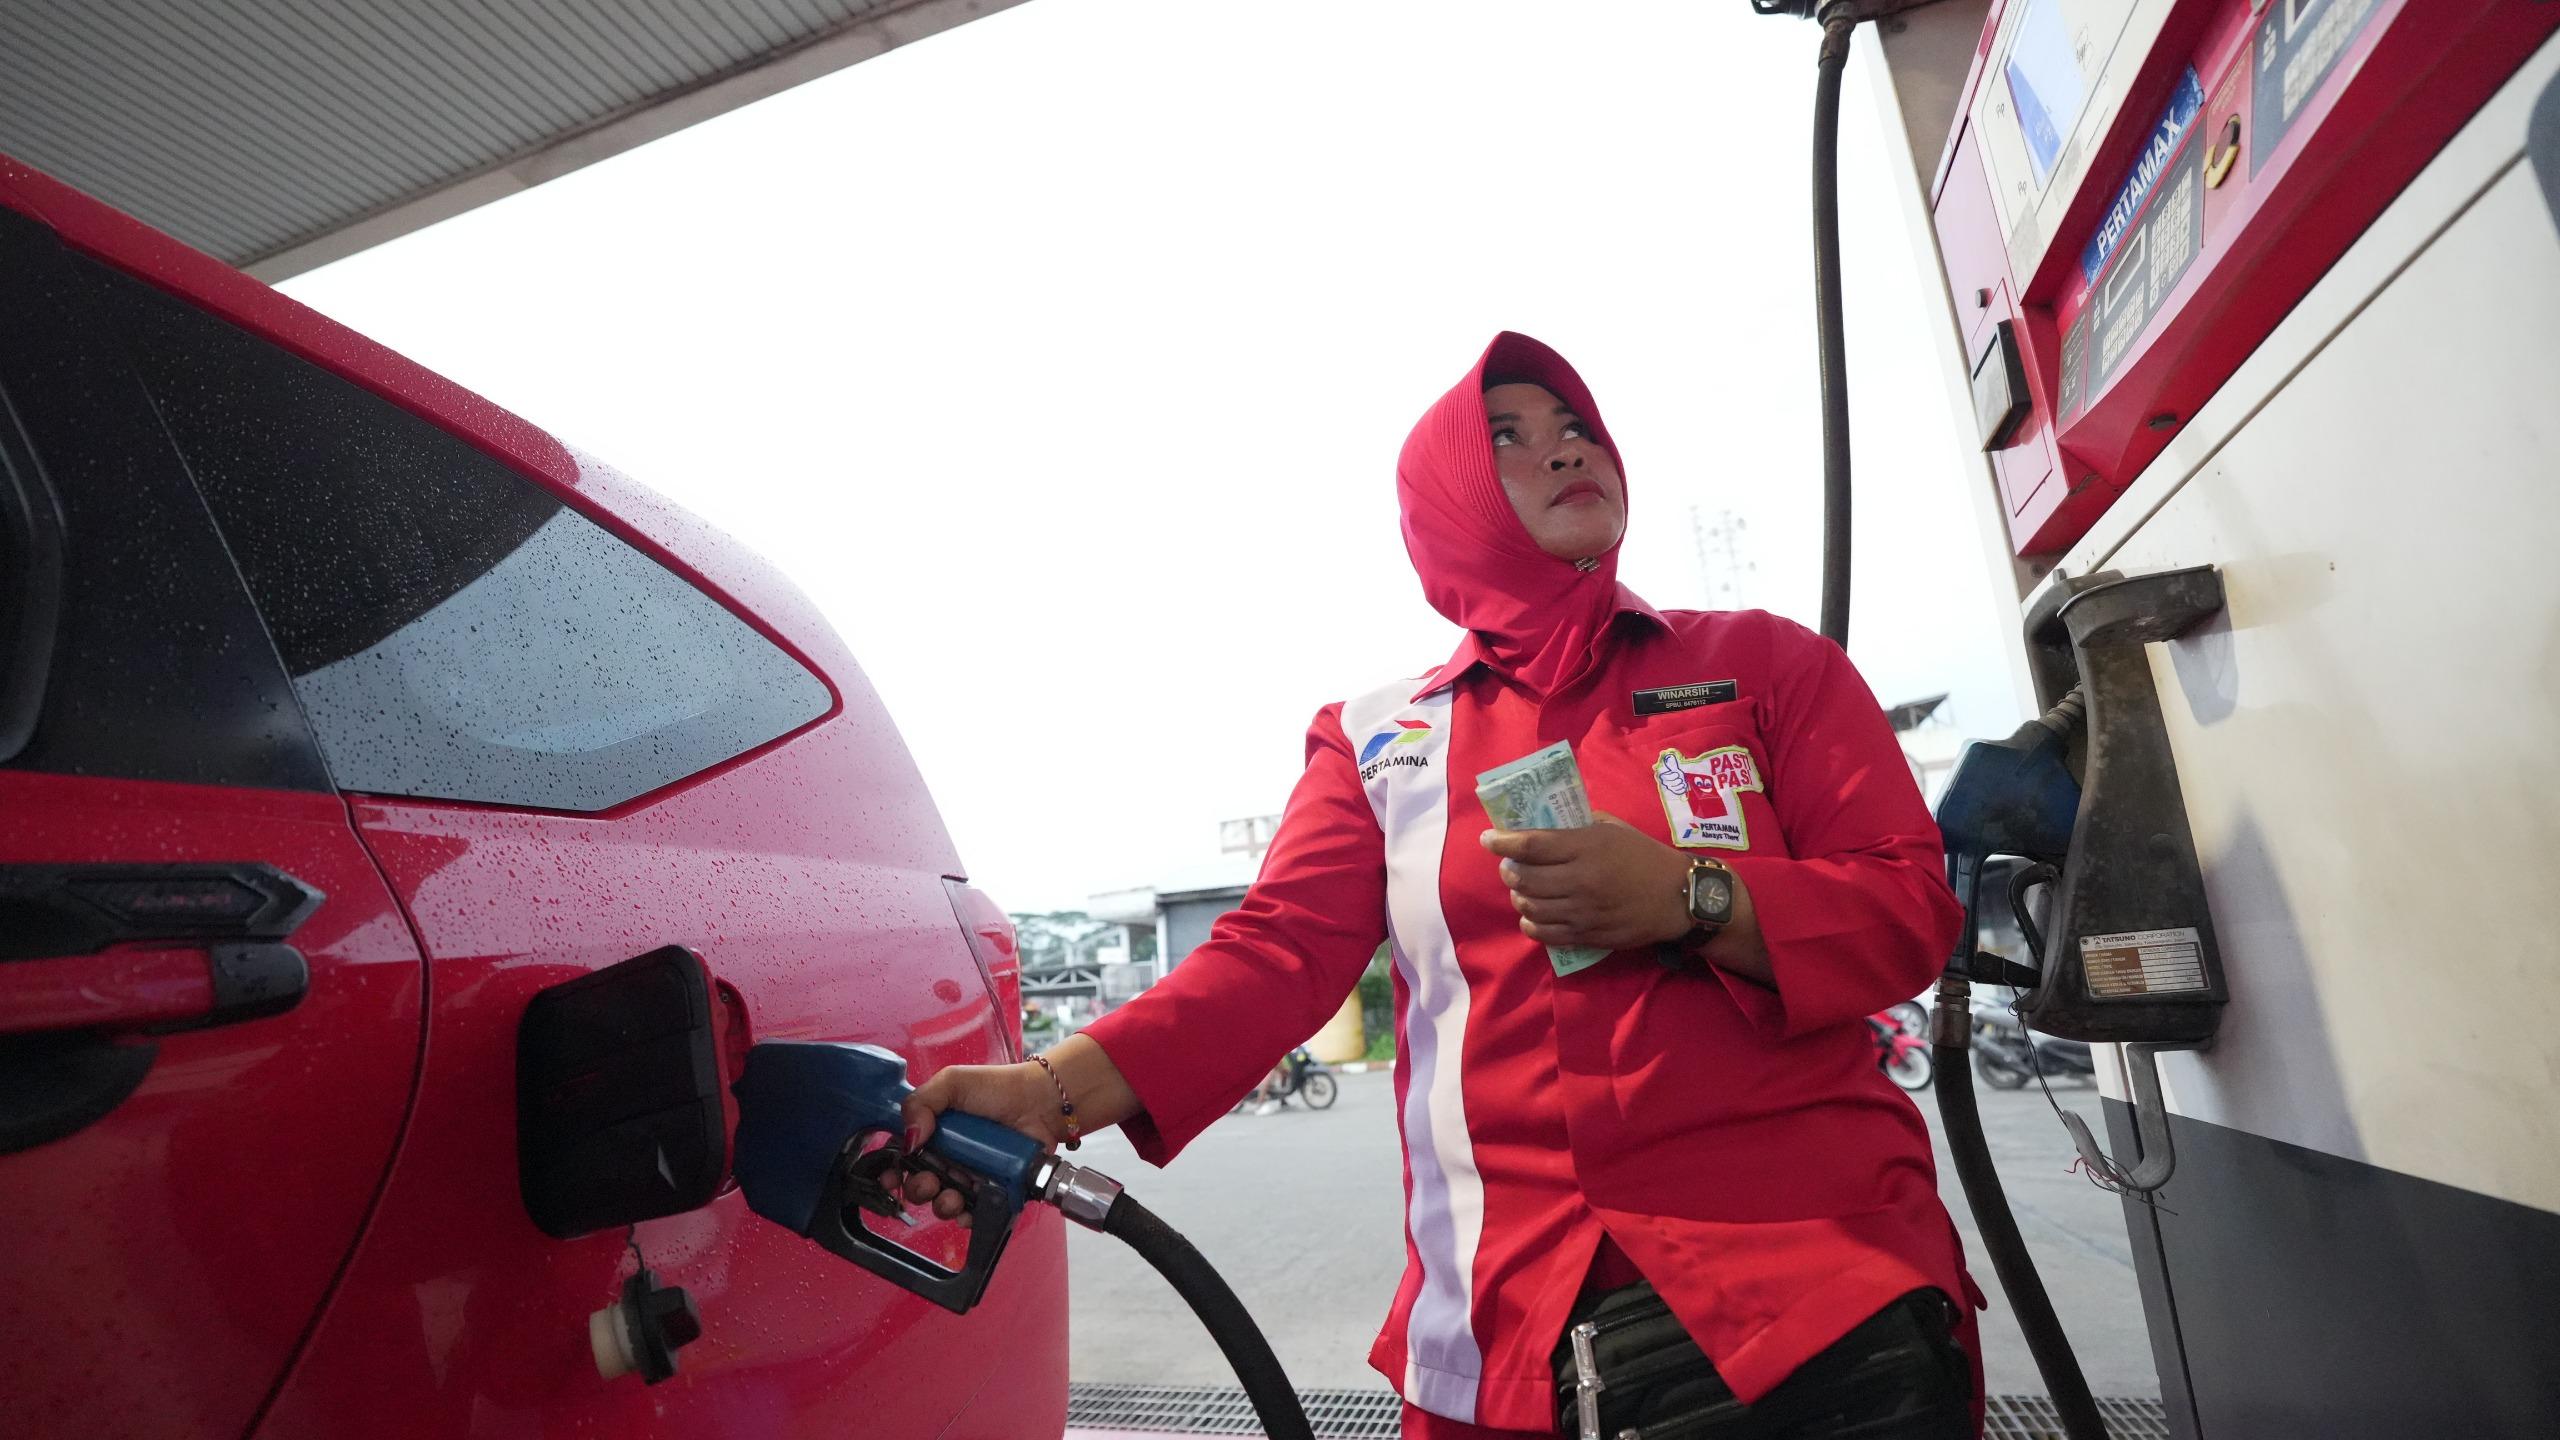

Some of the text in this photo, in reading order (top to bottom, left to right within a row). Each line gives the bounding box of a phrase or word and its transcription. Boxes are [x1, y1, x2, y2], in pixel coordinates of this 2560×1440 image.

[2096, 106, 2180, 259] PERTAMAX
[1658, 687, 1710, 700] WINARSIH
[1361, 756, 1428, 783] PERTAMINA
[1710, 753, 1751, 775] PASTI
[1700, 823, 1740, 834] PERTAMINA
[2102, 935, 2136, 943] TATSUNO
